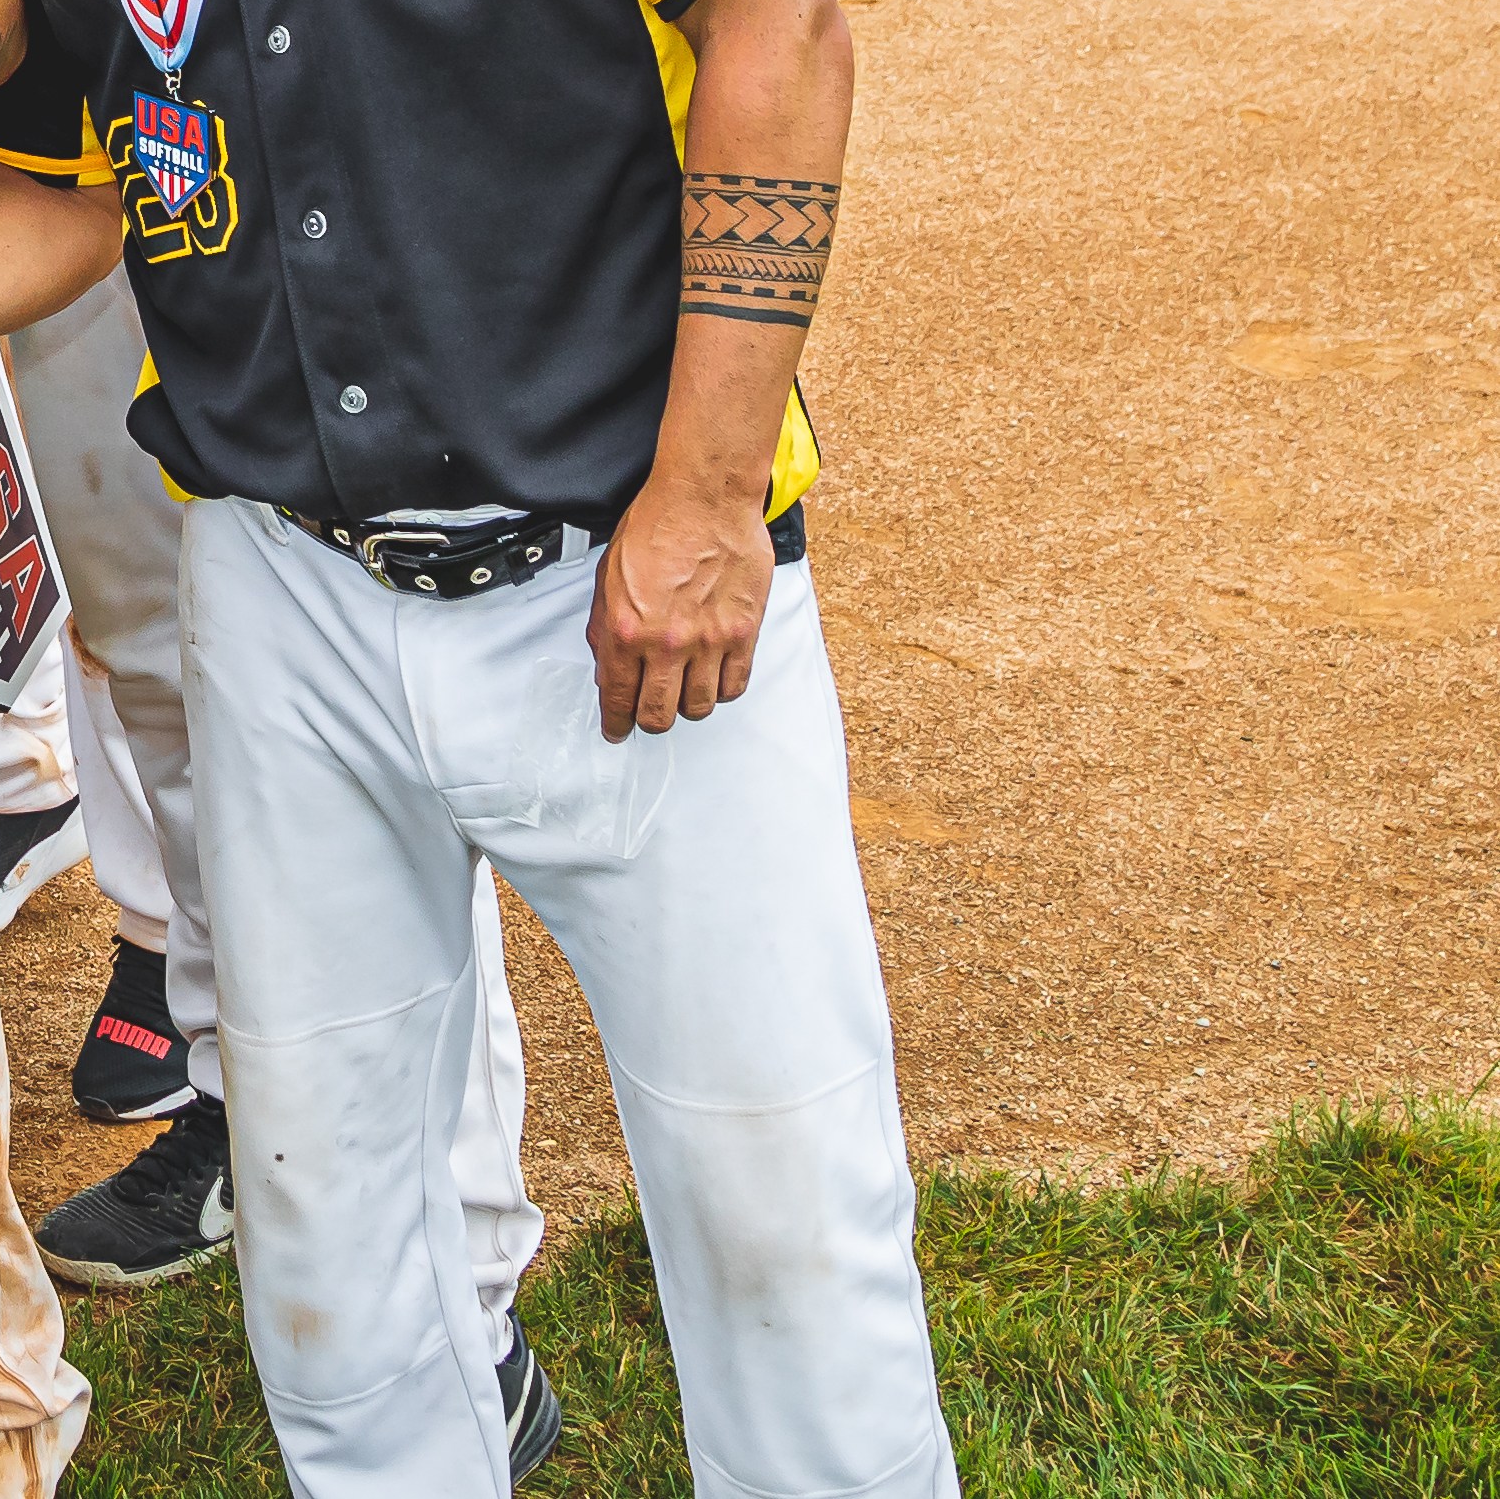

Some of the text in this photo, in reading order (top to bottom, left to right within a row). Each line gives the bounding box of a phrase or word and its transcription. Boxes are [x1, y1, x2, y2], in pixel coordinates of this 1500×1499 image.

[136, 97, 206, 155] USA
[138, 137, 206, 175] SOFTBALL
[96, 1014, 173, 1060] PUMA
